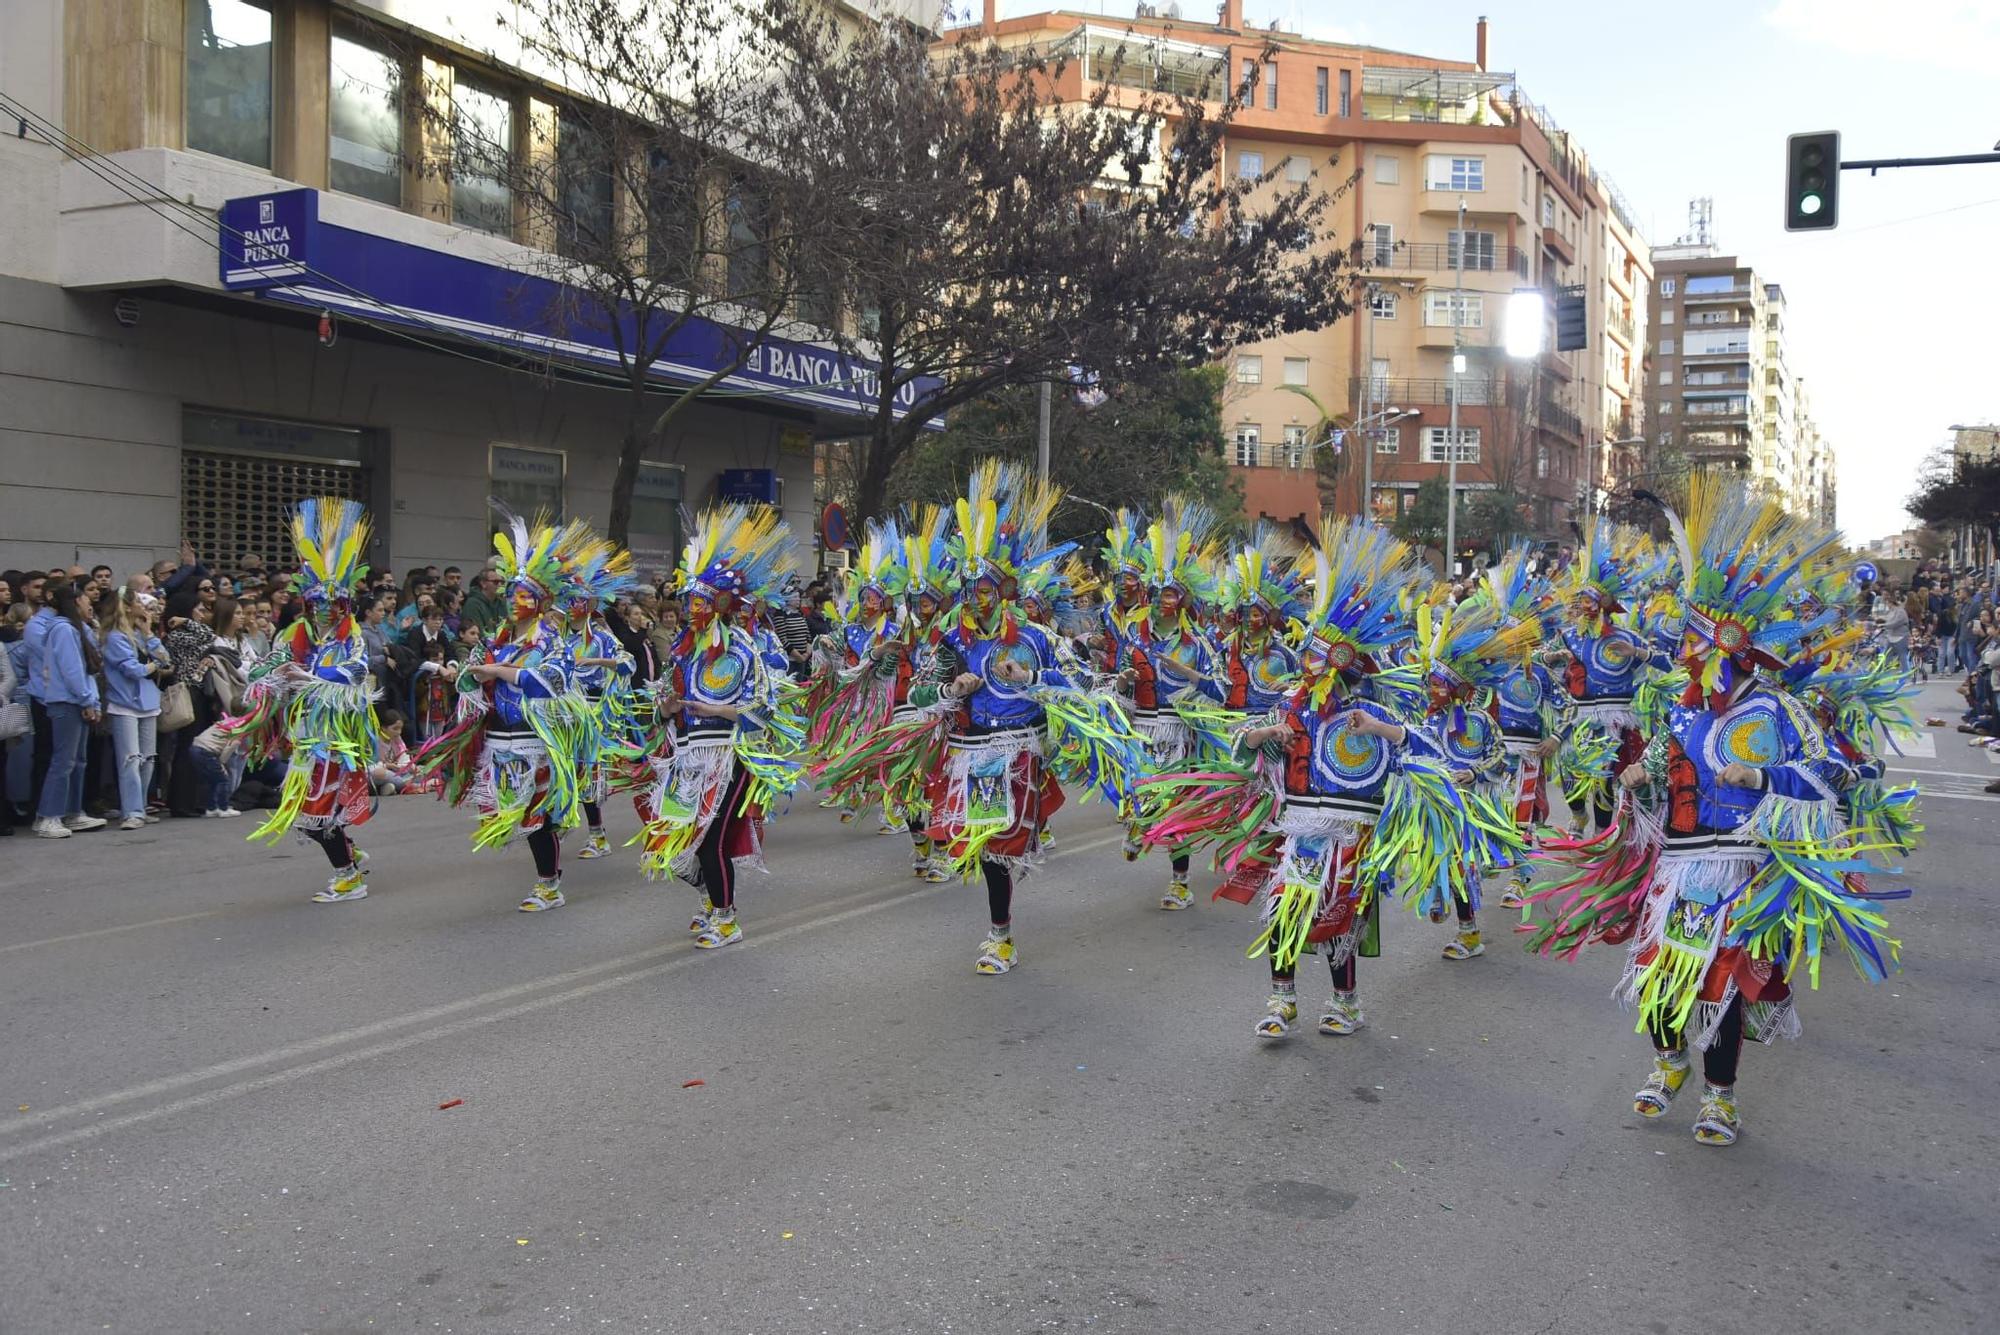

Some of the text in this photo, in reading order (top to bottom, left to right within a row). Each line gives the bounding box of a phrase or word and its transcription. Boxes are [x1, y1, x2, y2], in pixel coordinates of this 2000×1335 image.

[244, 226, 290, 246] BANCA
[769, 347, 915, 405] BANCA PUO
